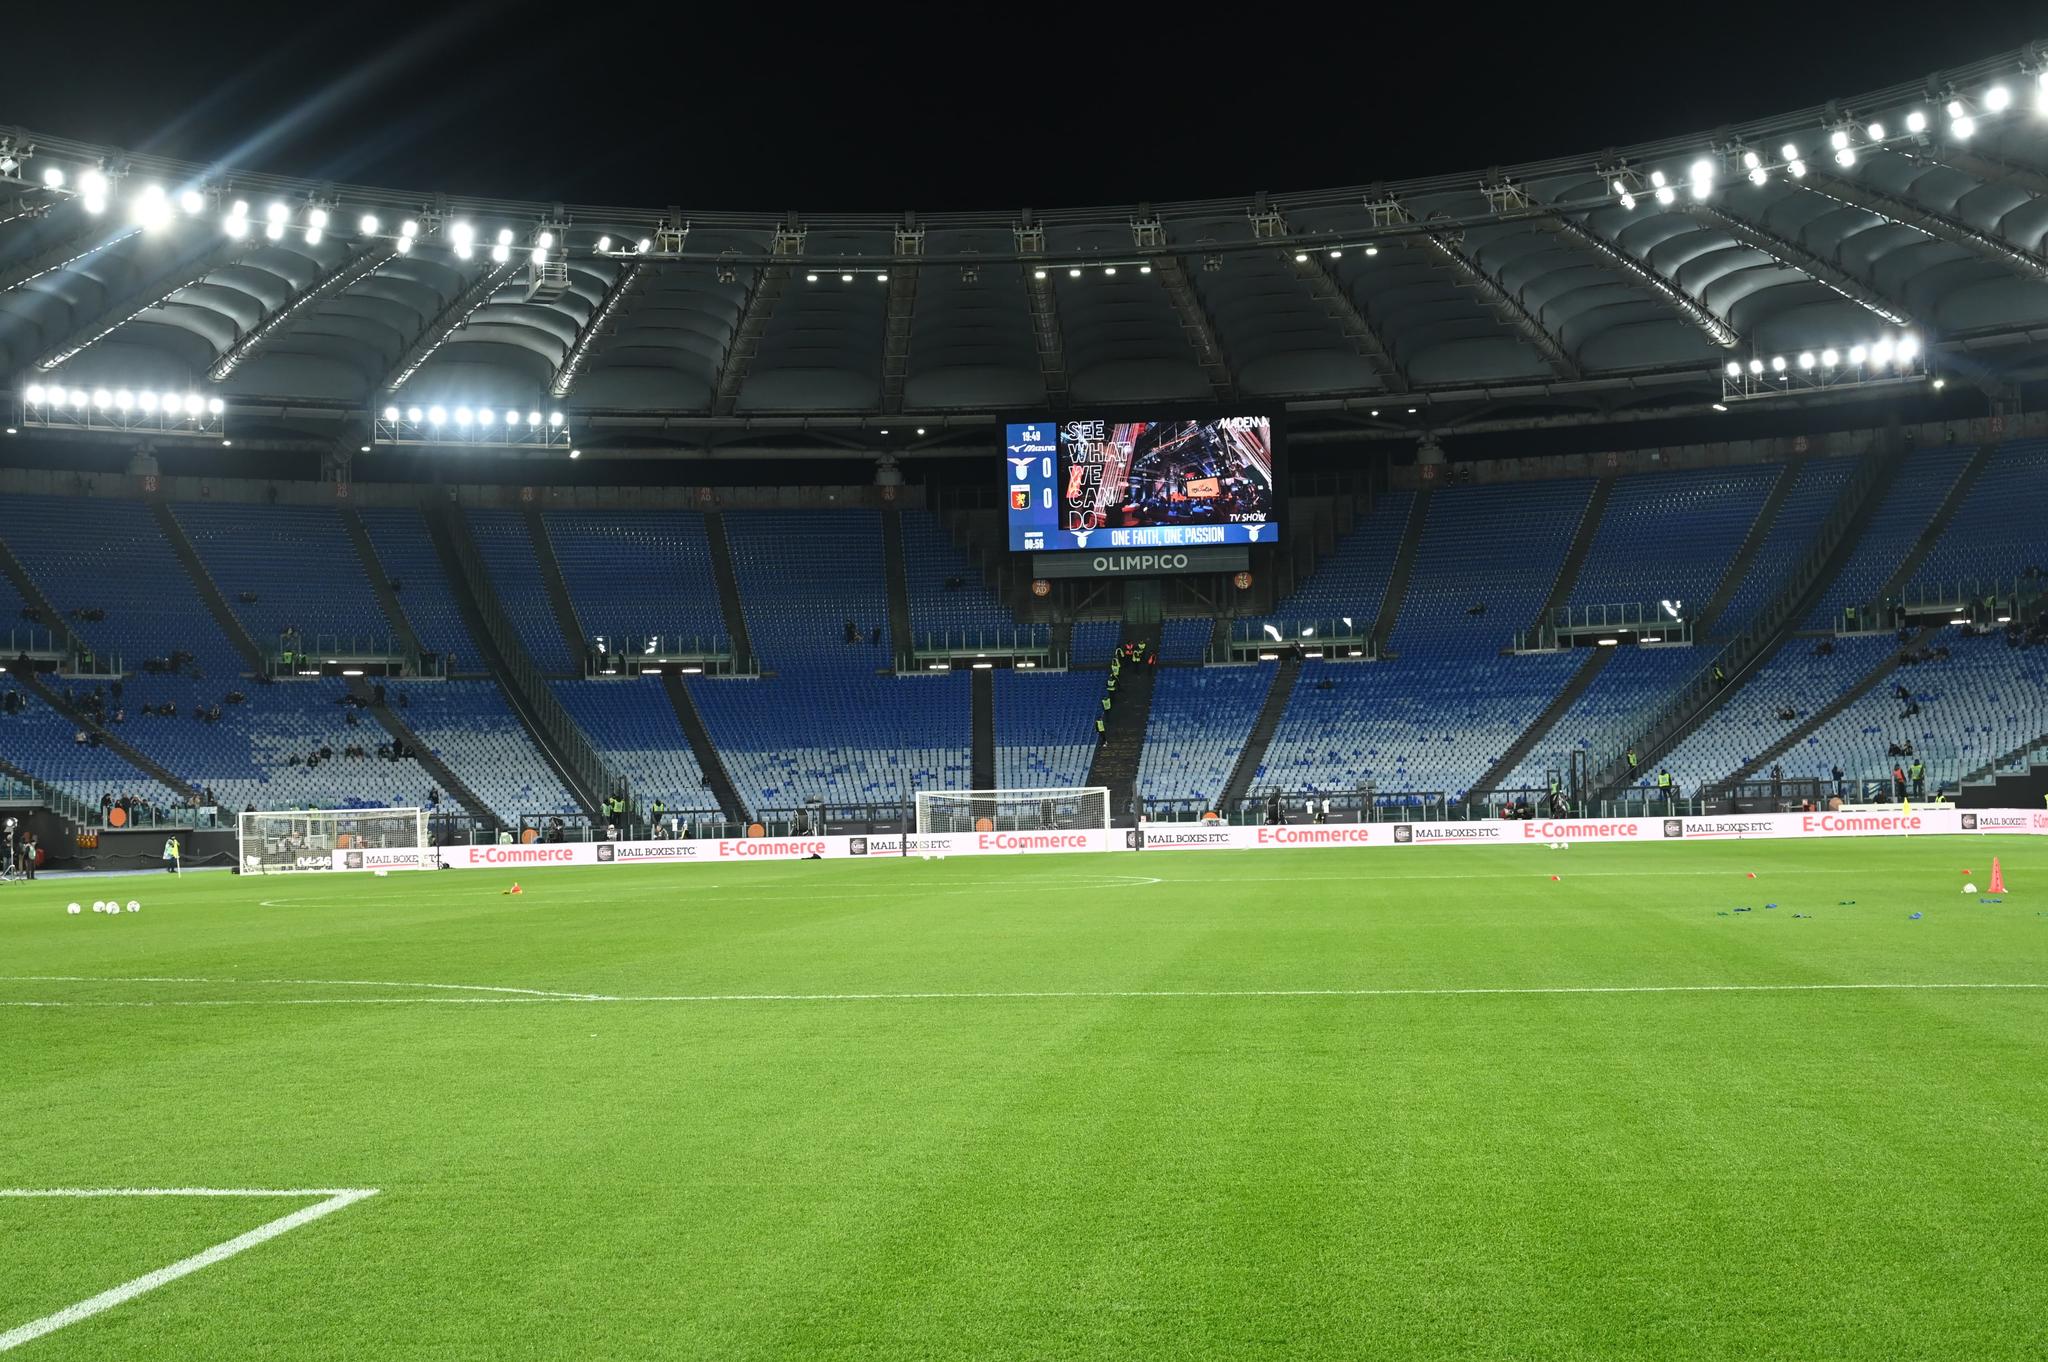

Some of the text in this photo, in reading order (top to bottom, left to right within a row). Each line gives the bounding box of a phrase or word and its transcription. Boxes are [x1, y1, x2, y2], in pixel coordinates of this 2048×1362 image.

[1067, 420, 1104, 440] SEE
[1068, 442, 1130, 463] WHAT
[1042, 457, 1051, 478] 0
[1068, 465, 1102, 485] WE
[1043, 488, 1052, 508] 0
[1069, 487, 1115, 508] CAN
[1069, 510, 1097, 531] DO
[1229, 512, 1266, 521] TV SHOW
[1111, 526, 1224, 546] ONE FAITH, ONE PASSION
[1093, 554, 1188, 571] OLIMPICO
[1686, 823, 1714, 832] MAIL
[1717, 823, 1750, 832] BOXES
[1803, 816, 1921, 832] E-Commerce
[1980, 818, 2001, 826] MAIL
[1258, 828, 1368, 843] E-Commerce
[1416, 829, 1443, 837] MAIL
[1445, 828, 1477, 837] BOXES
[1524, 822, 1637, 838] E-Commerce
[870, 842, 897, 850] MAIL
[979, 834, 1087, 849] E-Commerce
[1148, 835, 1174, 843] MAIL
[1176, 834, 1207, 843] BOXES
[469, 848, 573, 863] E-Commerce
[618, 848, 643, 856] MAIL
[645, 848, 675, 856] BOXES
[720, 841, 826, 856] E-Commerce
[366, 855, 391, 864] MAIL
